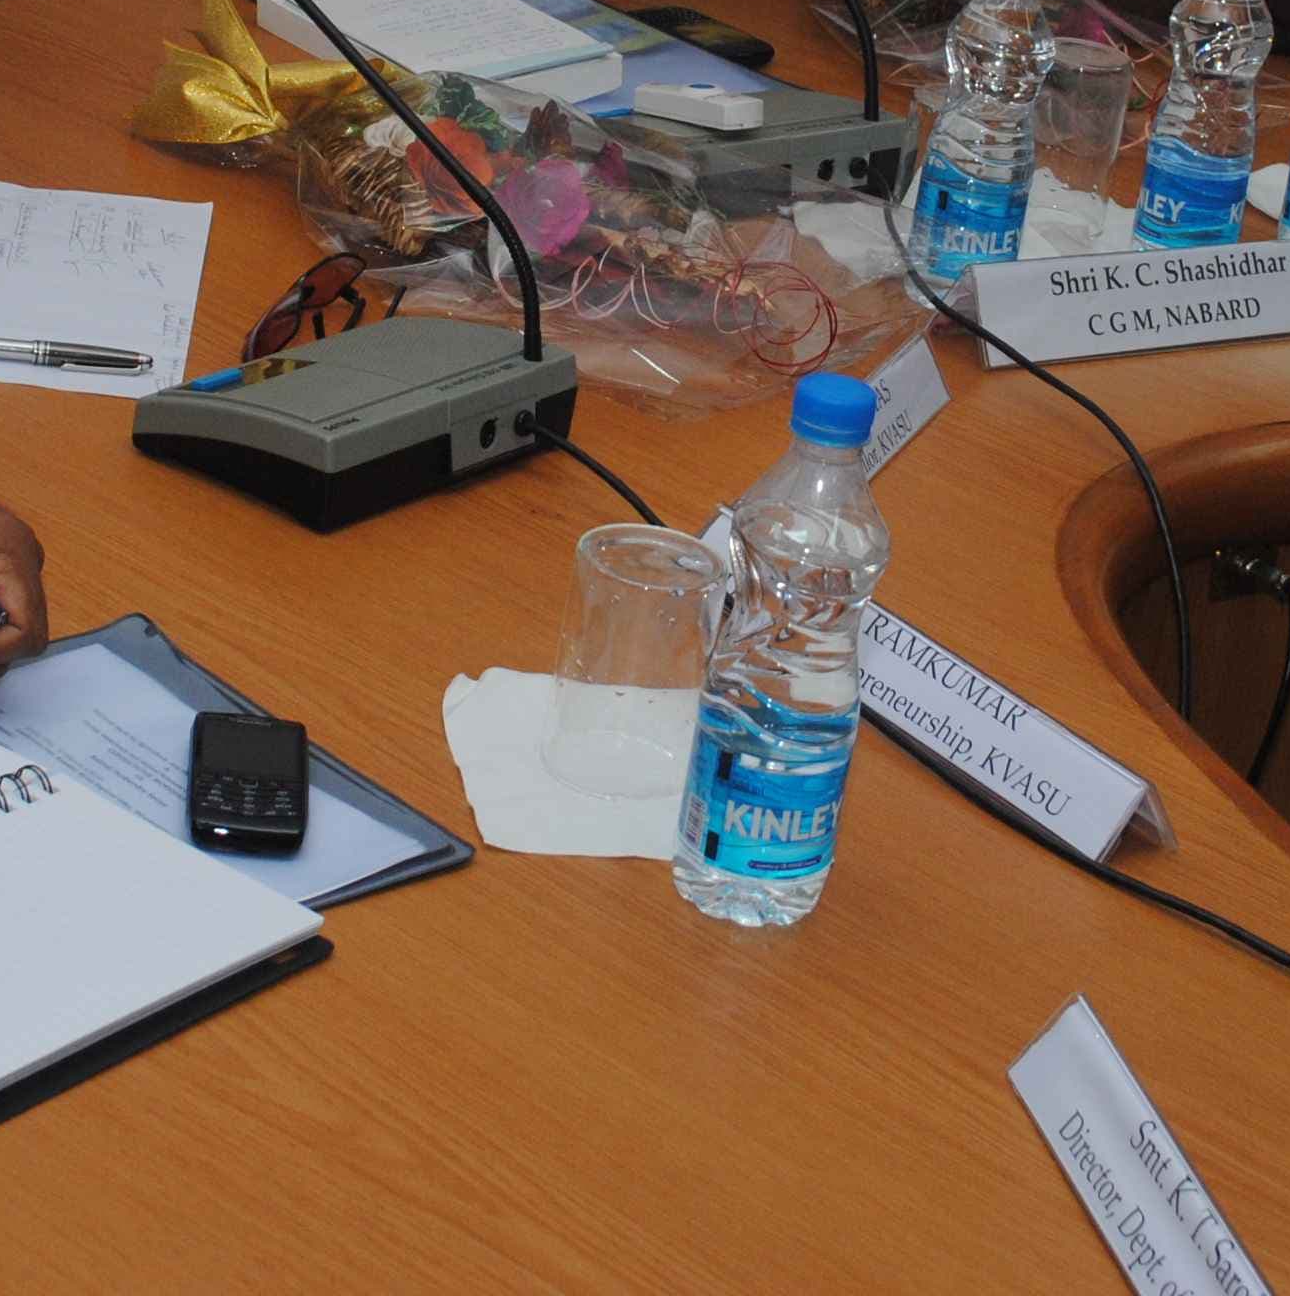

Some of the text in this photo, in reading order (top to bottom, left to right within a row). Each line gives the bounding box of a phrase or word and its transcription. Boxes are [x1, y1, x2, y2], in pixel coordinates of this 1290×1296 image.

[1050, 251, 1287, 296] Shri K. C. Shashidhar
[1088, 296, 1262, 336] C G M, NABARD
[864, 612, 1028, 732] RAMKUMAR
[979, 744, 1073, 817] KVASU
[724, 796, 842, 842] KINLEY
[1058, 1109, 1123, 1219] Director,
[1117, 1205, 1166, 1284] Dept.
[1129, 1120, 1172, 1190] Smt.
[1167, 1175, 1199, 1222] K.
